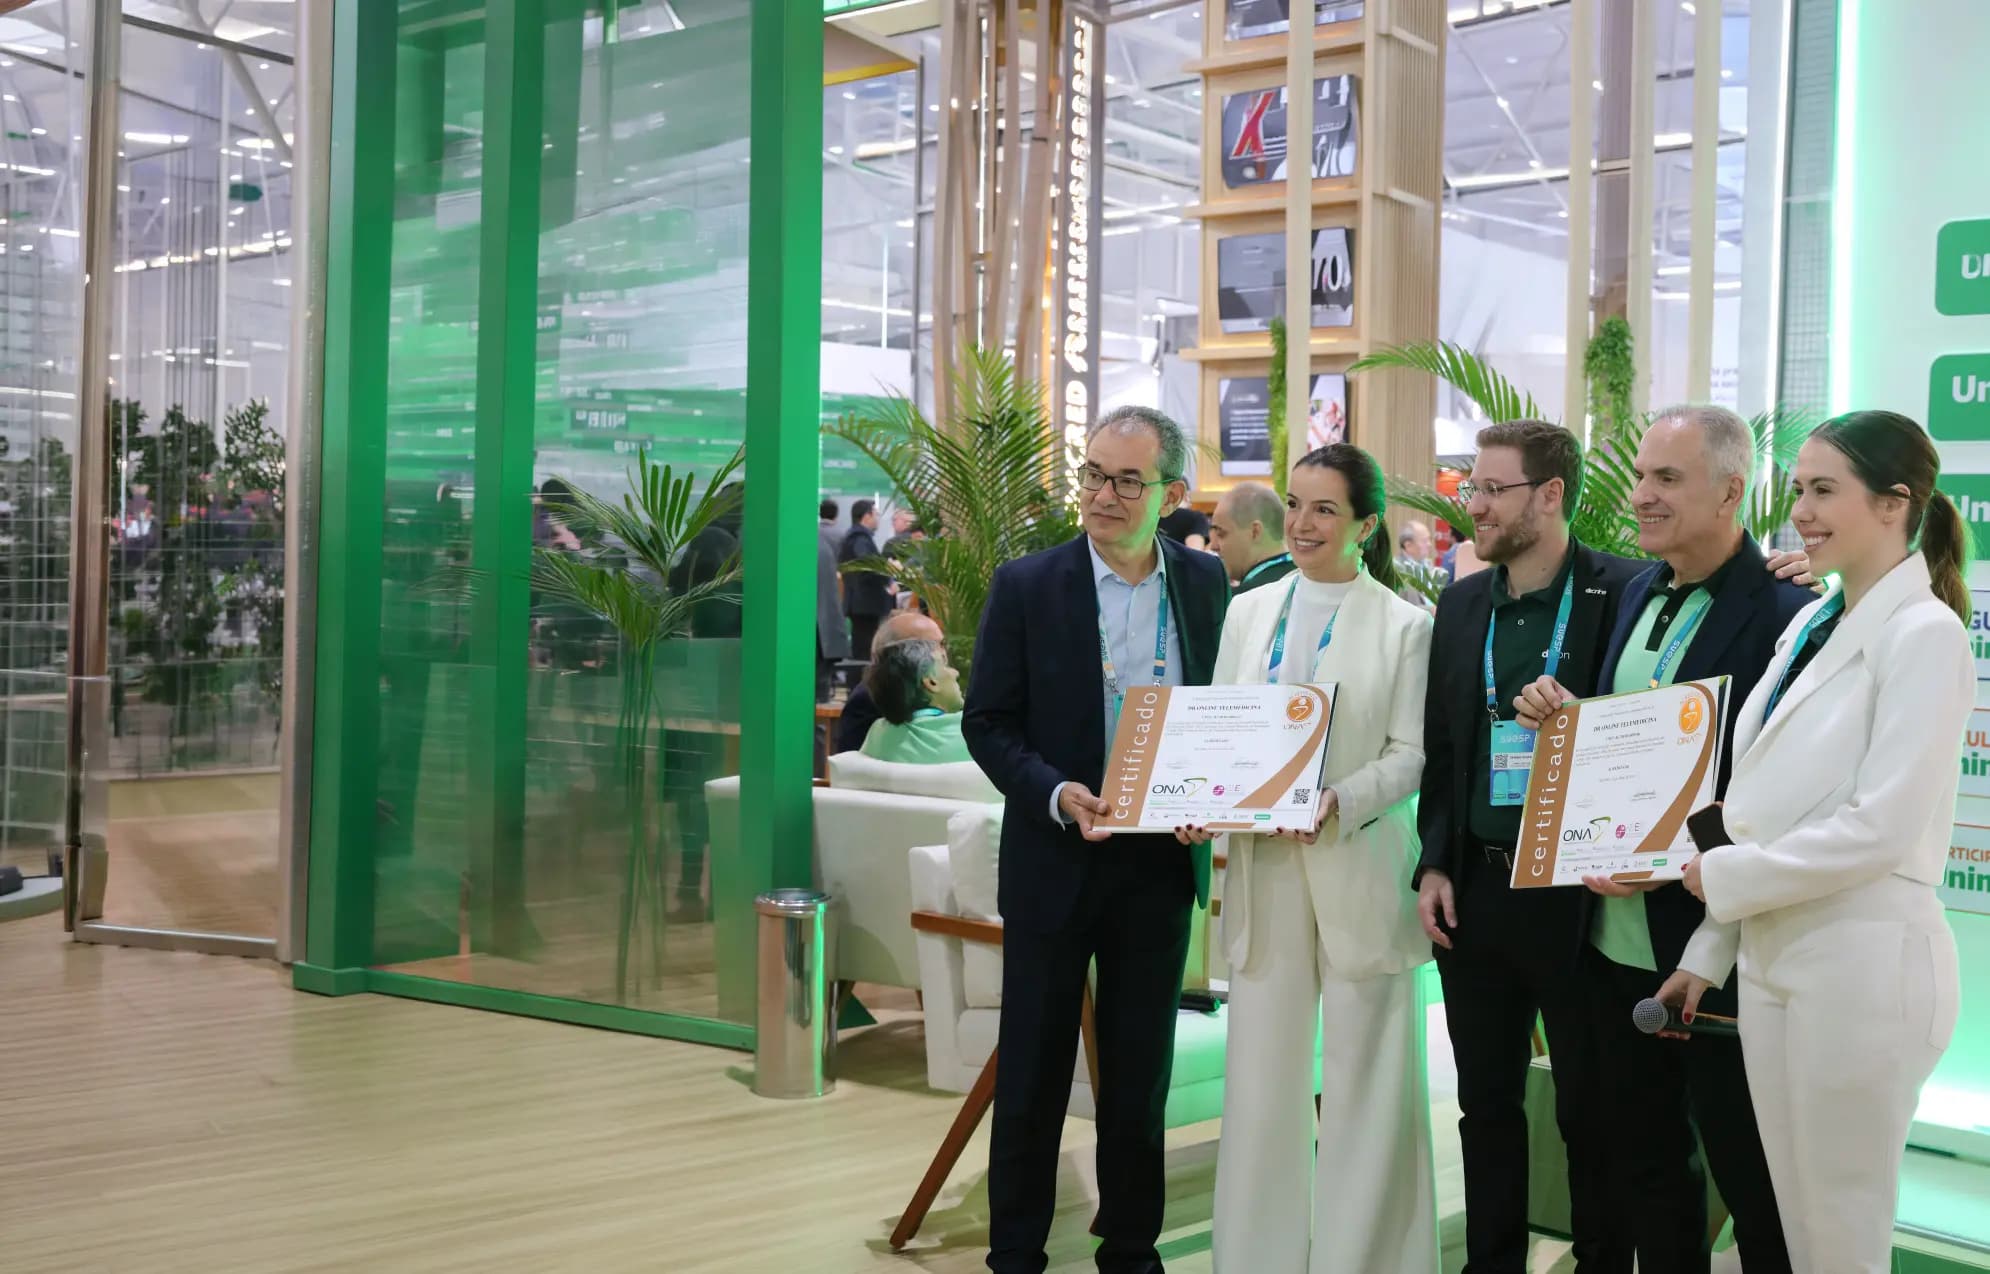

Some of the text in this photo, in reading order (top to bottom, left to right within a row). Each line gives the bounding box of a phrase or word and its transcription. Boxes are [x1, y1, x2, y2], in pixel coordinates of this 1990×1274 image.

[1114, 692, 1158, 820] certificado
[1152, 784, 1186, 794] ONA
[1532, 714, 1568, 877] certificado
[1563, 828, 1592, 842] ONA
